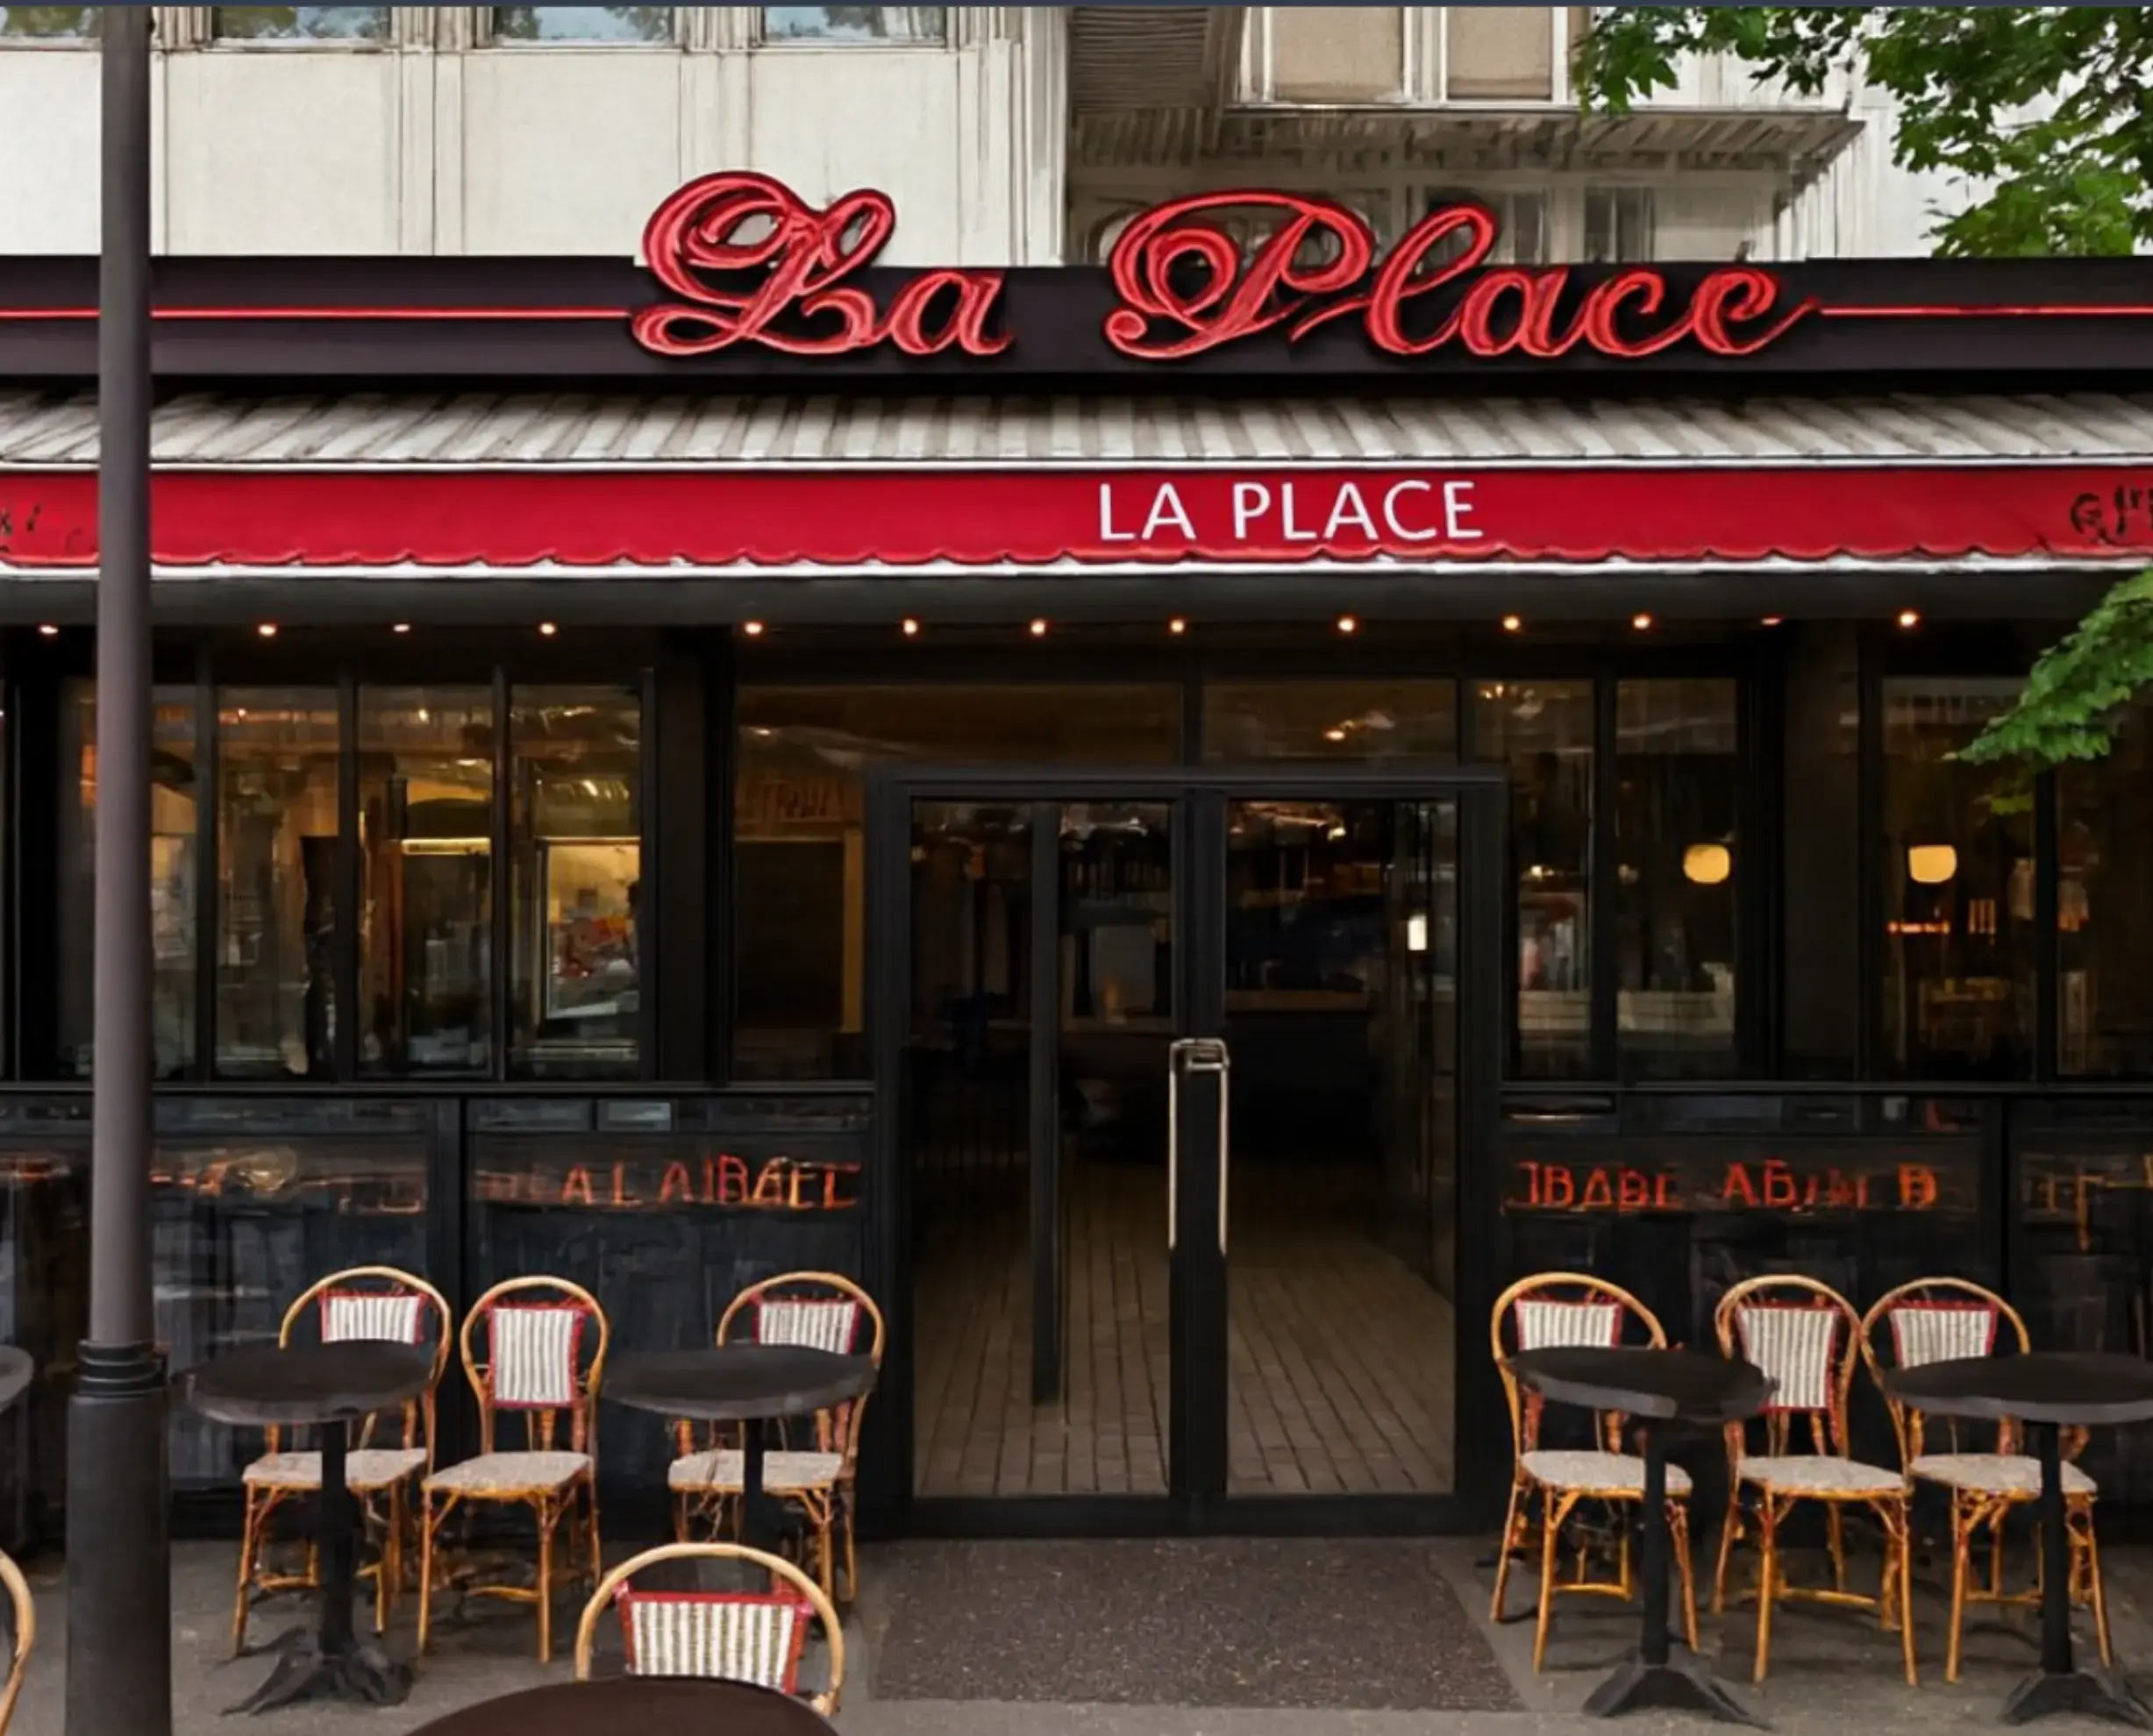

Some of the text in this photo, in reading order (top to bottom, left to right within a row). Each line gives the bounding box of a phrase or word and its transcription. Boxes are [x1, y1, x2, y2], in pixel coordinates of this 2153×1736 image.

[631, 169, 1814, 360] La Place
[1100, 480, 1484, 541] LA PLACE
